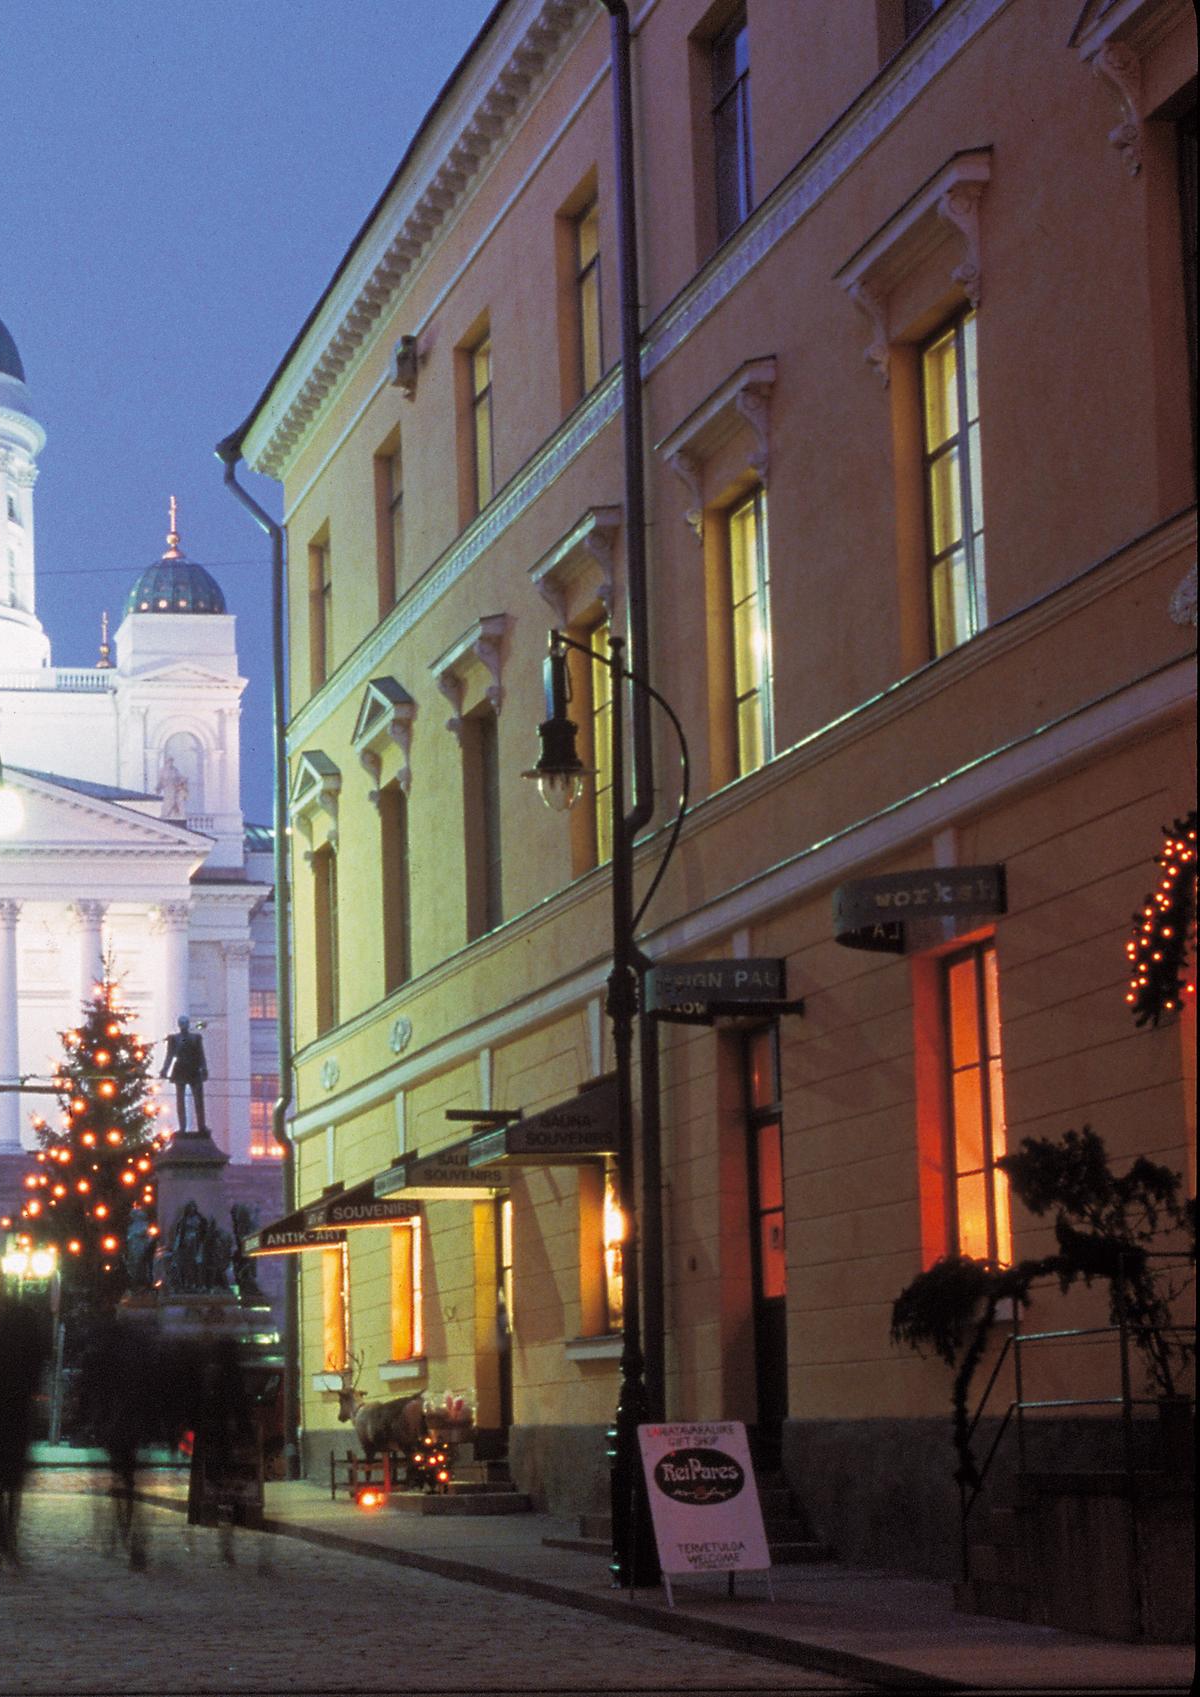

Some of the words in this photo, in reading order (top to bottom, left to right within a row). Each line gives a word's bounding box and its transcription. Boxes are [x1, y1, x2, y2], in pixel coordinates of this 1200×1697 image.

[423, 1168, 503, 1182] SOUVENIRS
[332, 1202, 418, 1221] SOUVENIRS
[266, 1230, 342, 1246] ANTIK-ART
